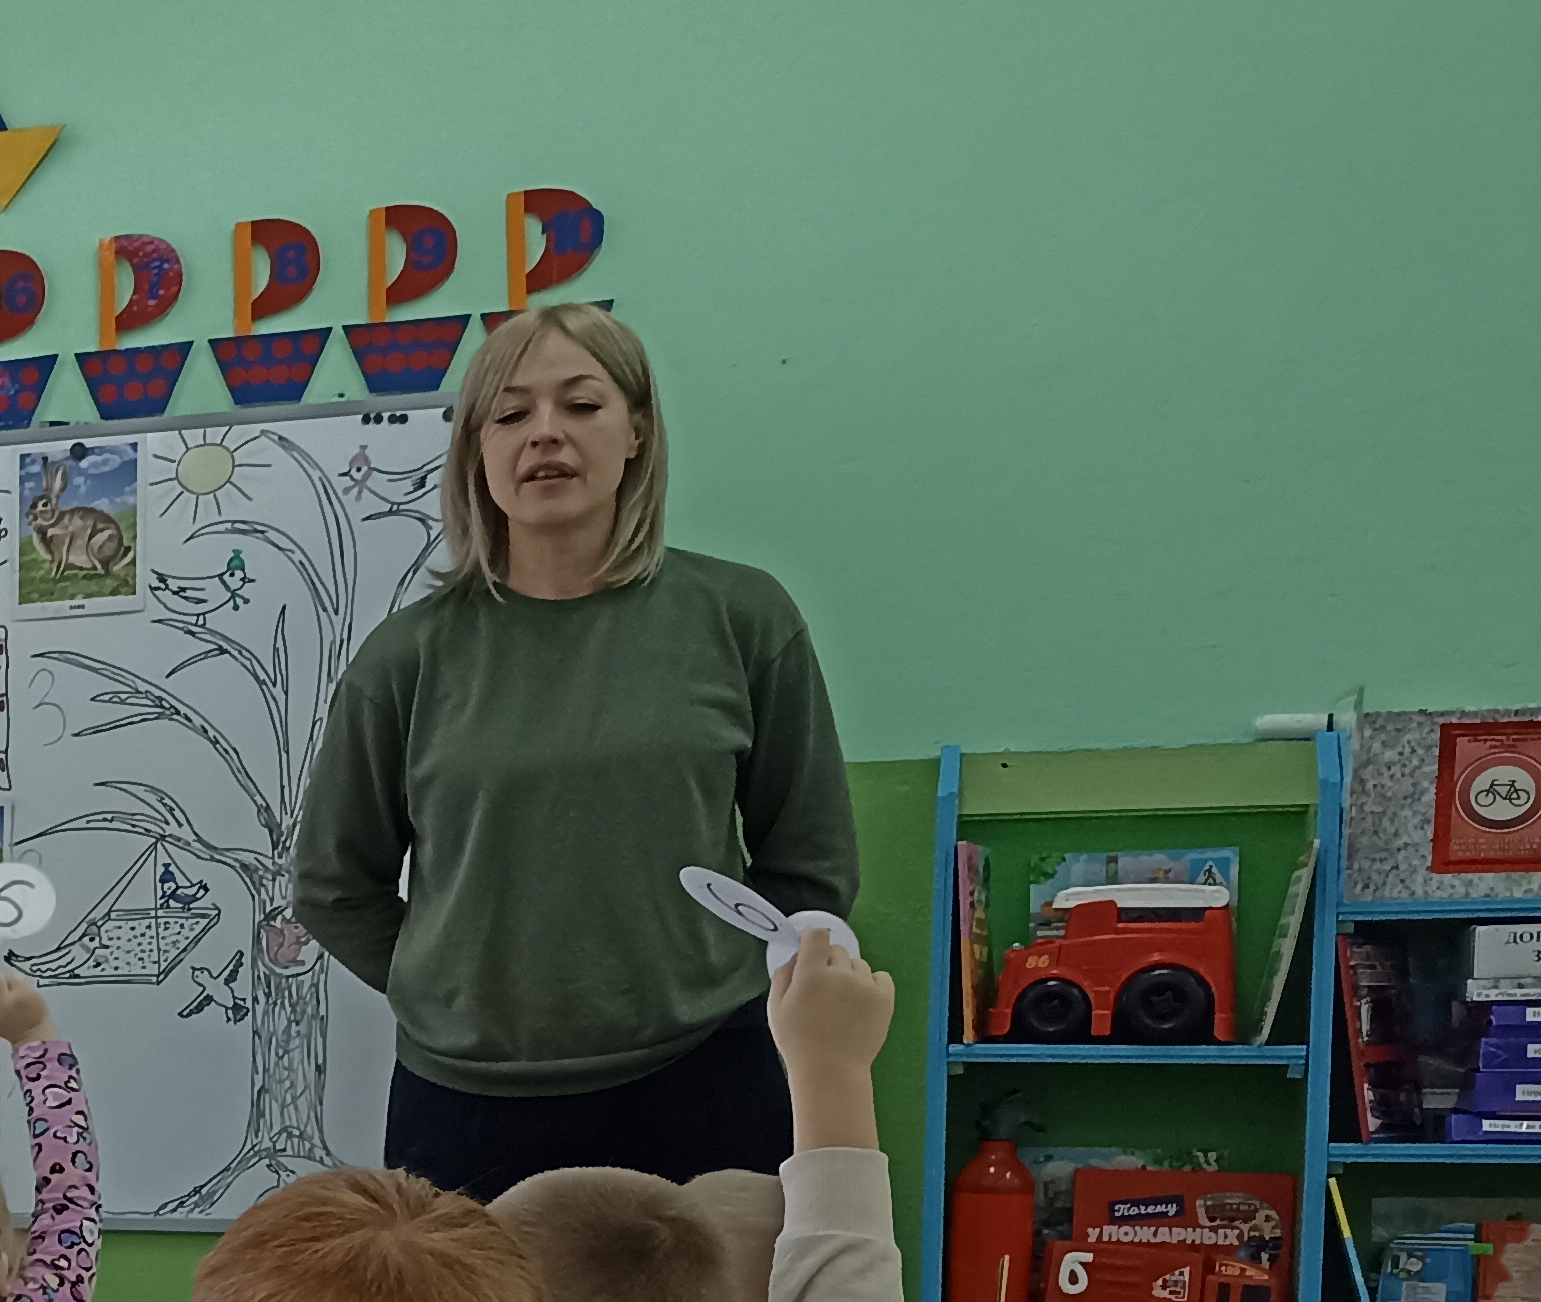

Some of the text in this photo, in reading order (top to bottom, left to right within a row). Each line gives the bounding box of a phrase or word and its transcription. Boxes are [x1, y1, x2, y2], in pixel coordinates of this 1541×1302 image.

[411, 227, 448, 270] 9
[542, 207, 605, 255] 10
[142, 259, 169, 301] 7
[276, 242, 309, 285] 8
[4, 273, 35, 314] 6
[28, 668, 67, 747] 3
[706, 882, 779, 932] 6
[1113, 1202, 1180, 1217] Почему
[1102, 1225, 1240, 1246] ПОЖАРНЫХ
